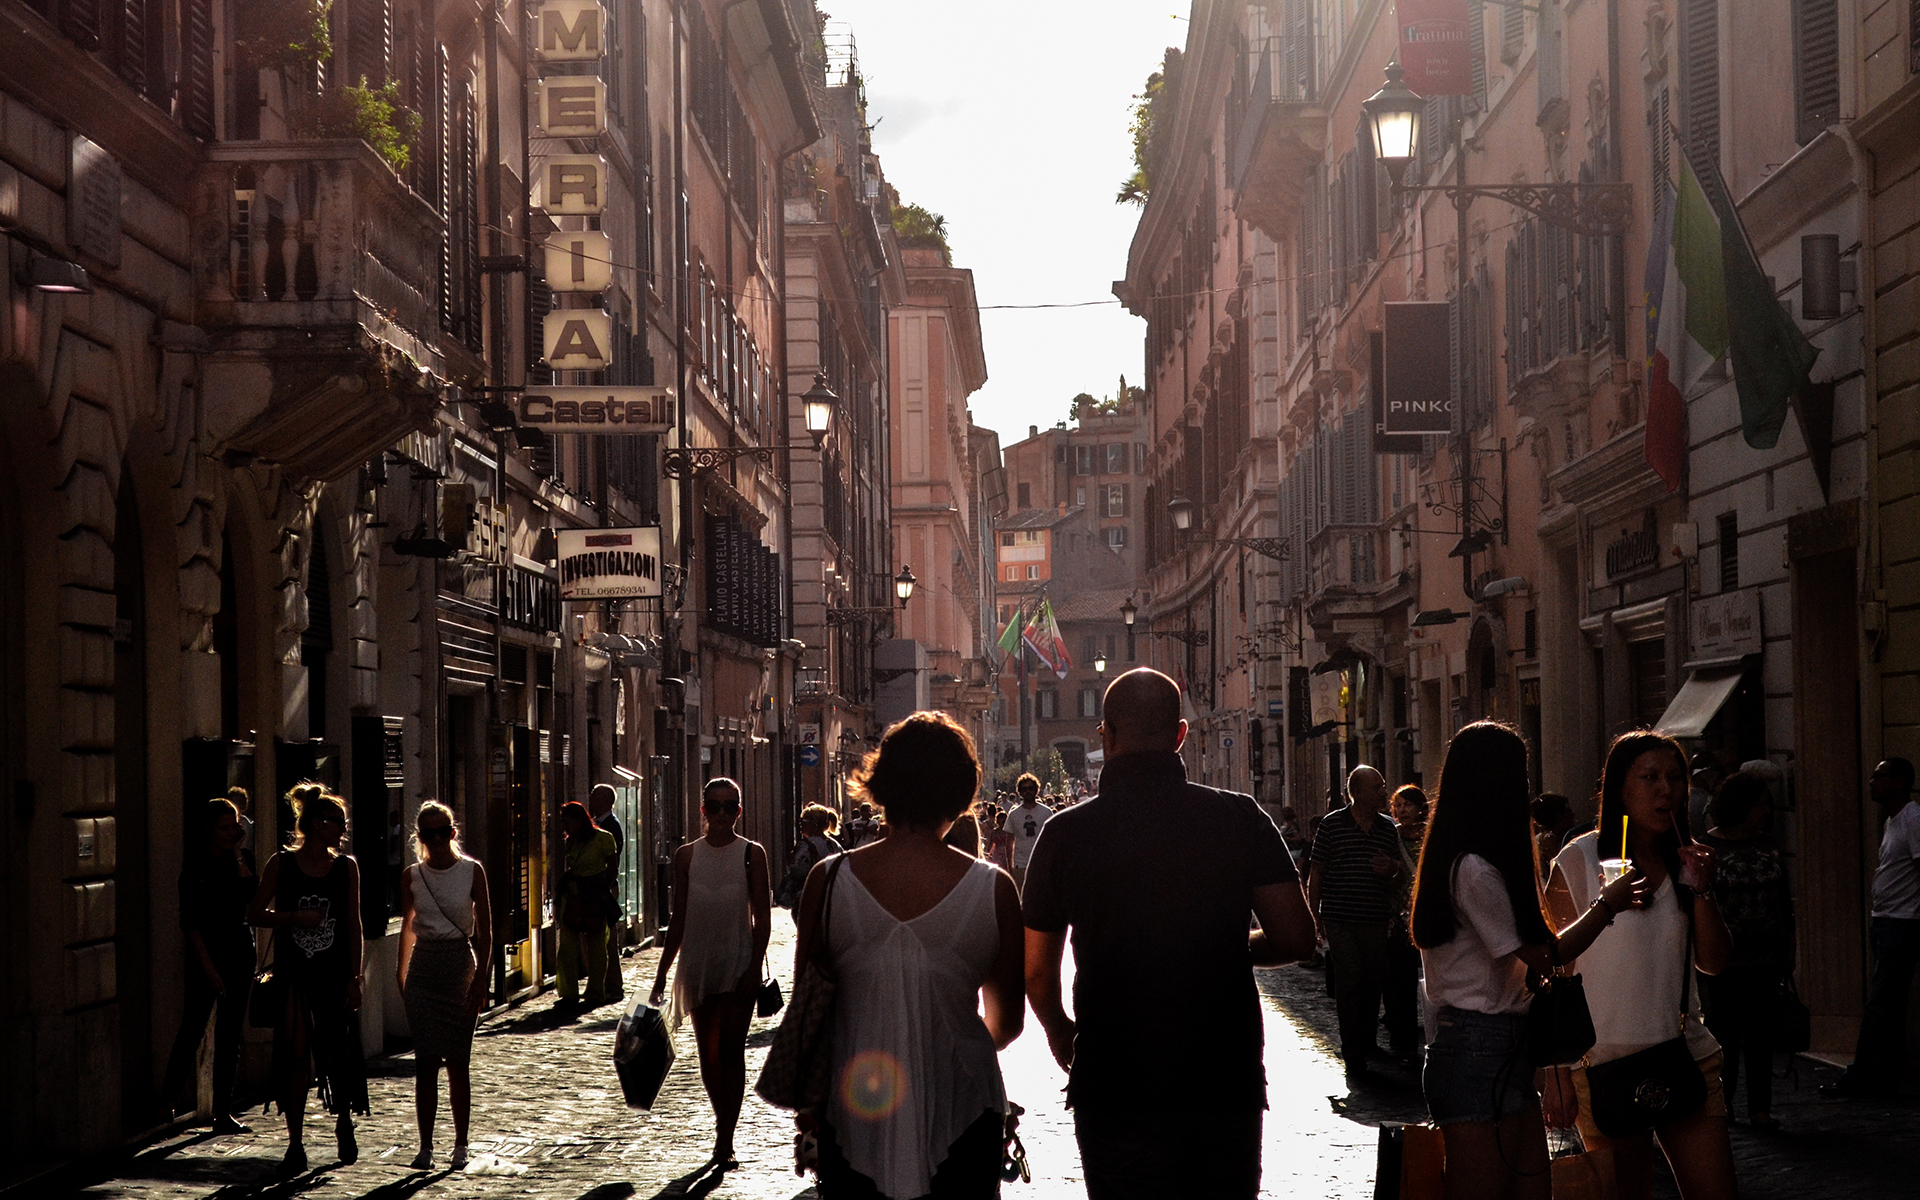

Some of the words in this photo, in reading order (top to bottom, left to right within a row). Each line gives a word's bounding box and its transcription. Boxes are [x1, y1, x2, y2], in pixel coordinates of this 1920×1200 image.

[1408, 26, 1464, 43] frattina
[543, 9, 603, 360] MERIA
[520, 396, 674, 424] Castelli
[561, 551, 655, 585] INVESTIGAZIONI
[716, 522, 727, 583] CASTELLANI
[597, 586, 646, 595] 066789341
[716, 588, 728, 623] FLAVIO
